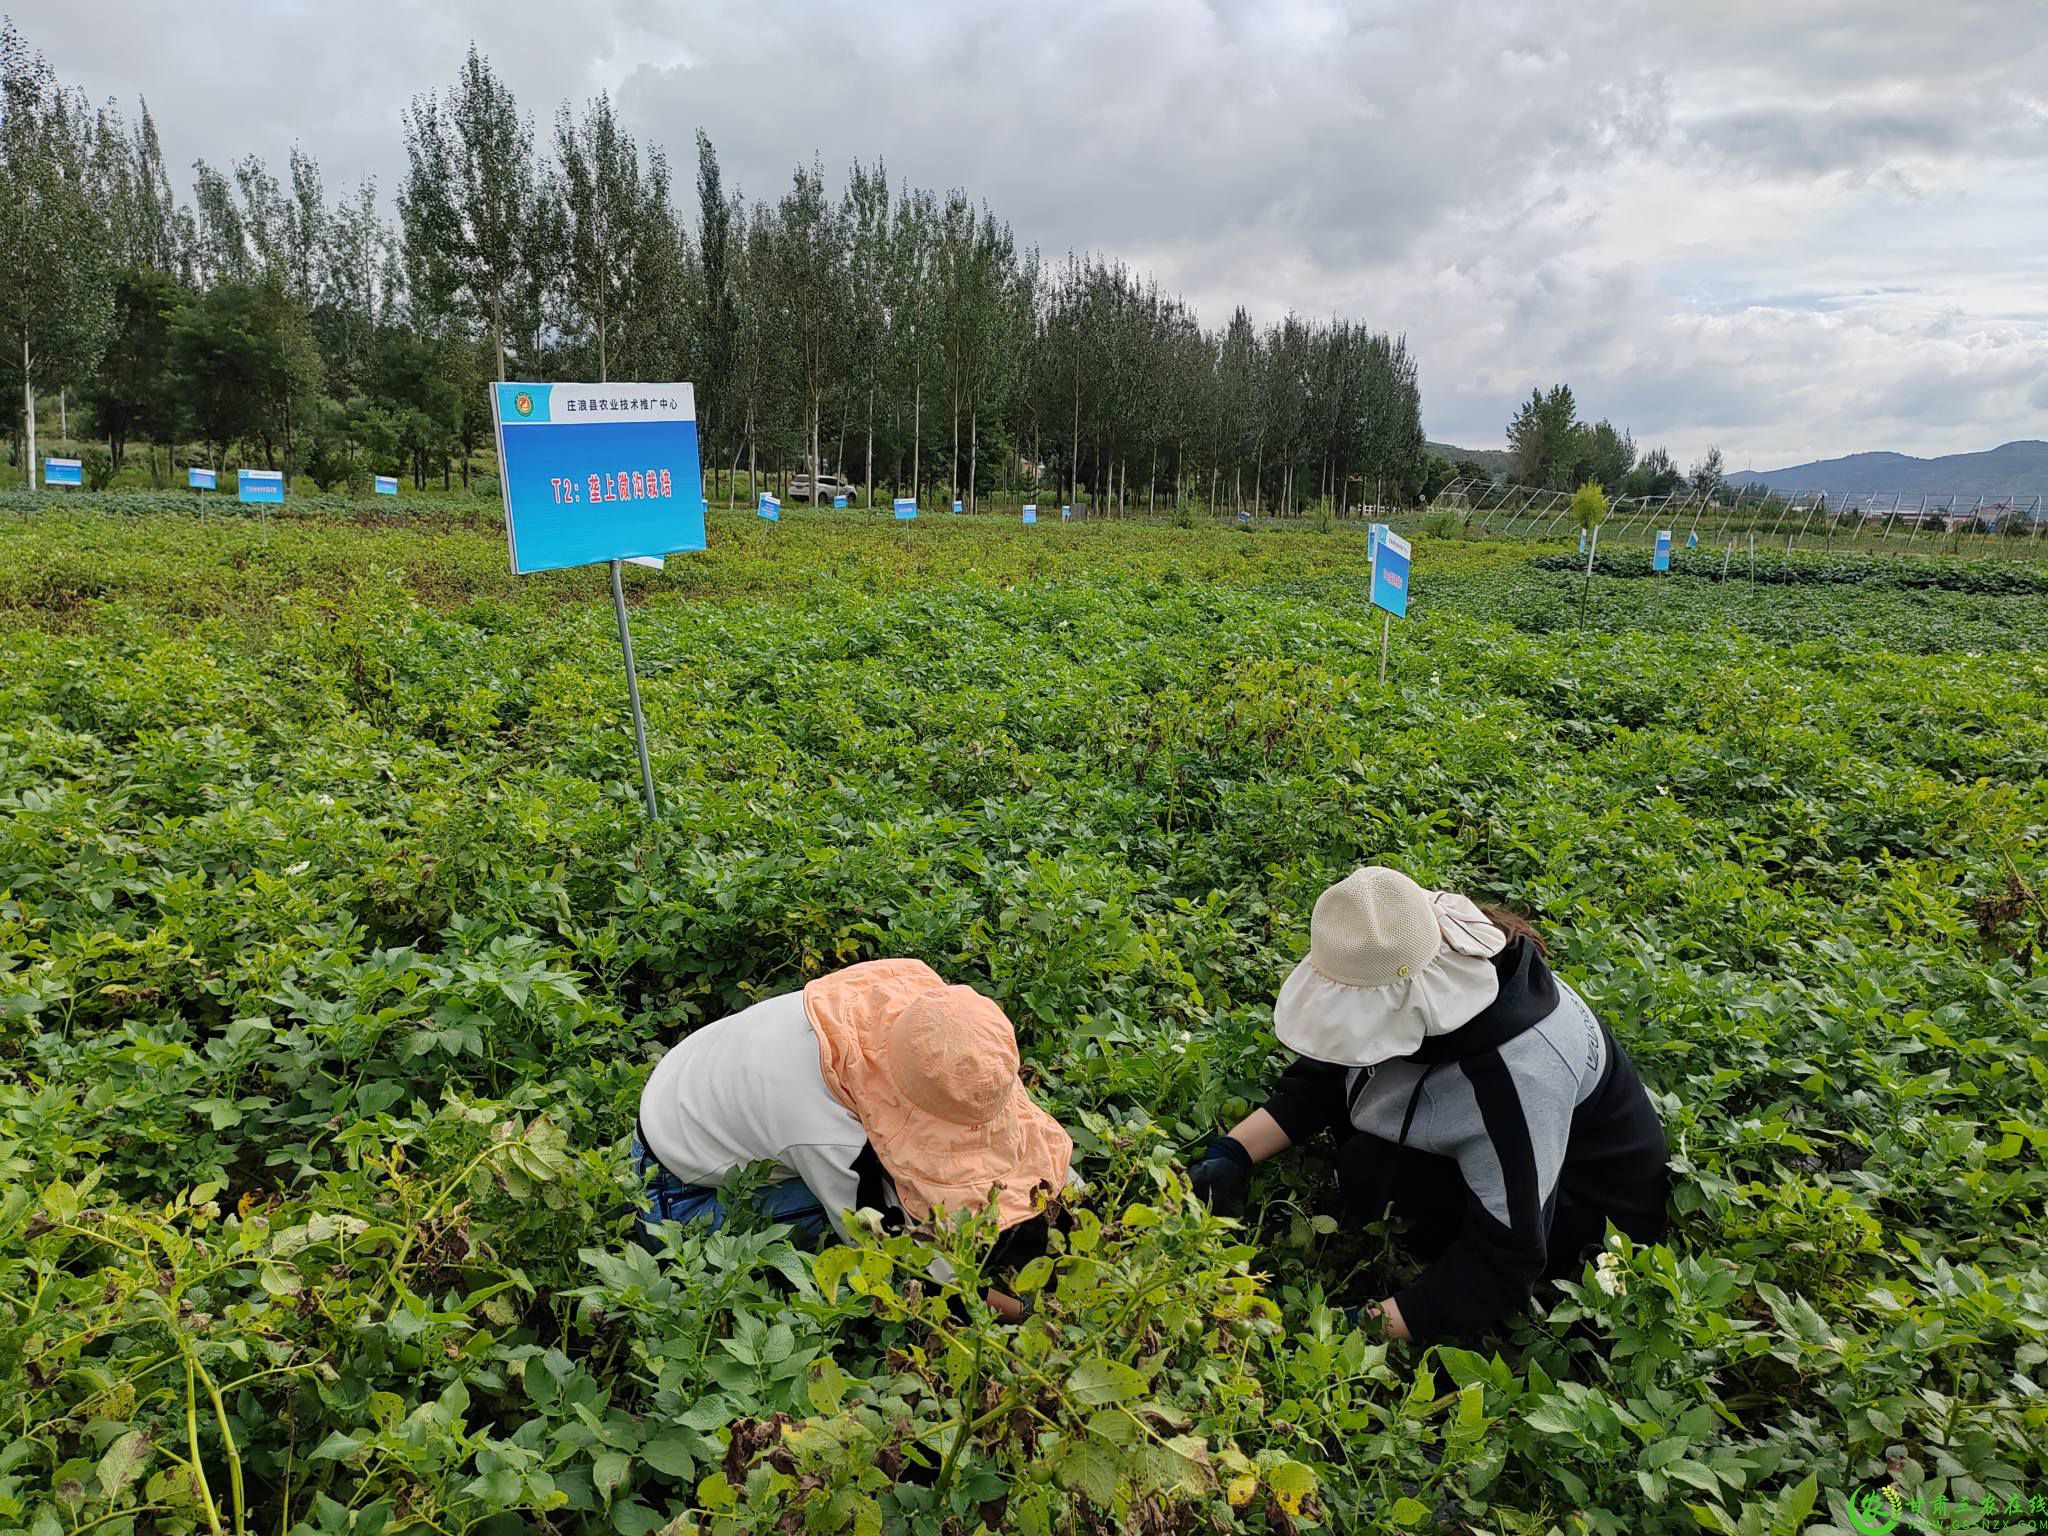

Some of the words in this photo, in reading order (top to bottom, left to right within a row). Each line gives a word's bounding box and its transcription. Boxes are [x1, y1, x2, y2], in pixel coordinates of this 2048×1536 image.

[567, 398, 678, 412] 庄浪县农业技术推广中心
